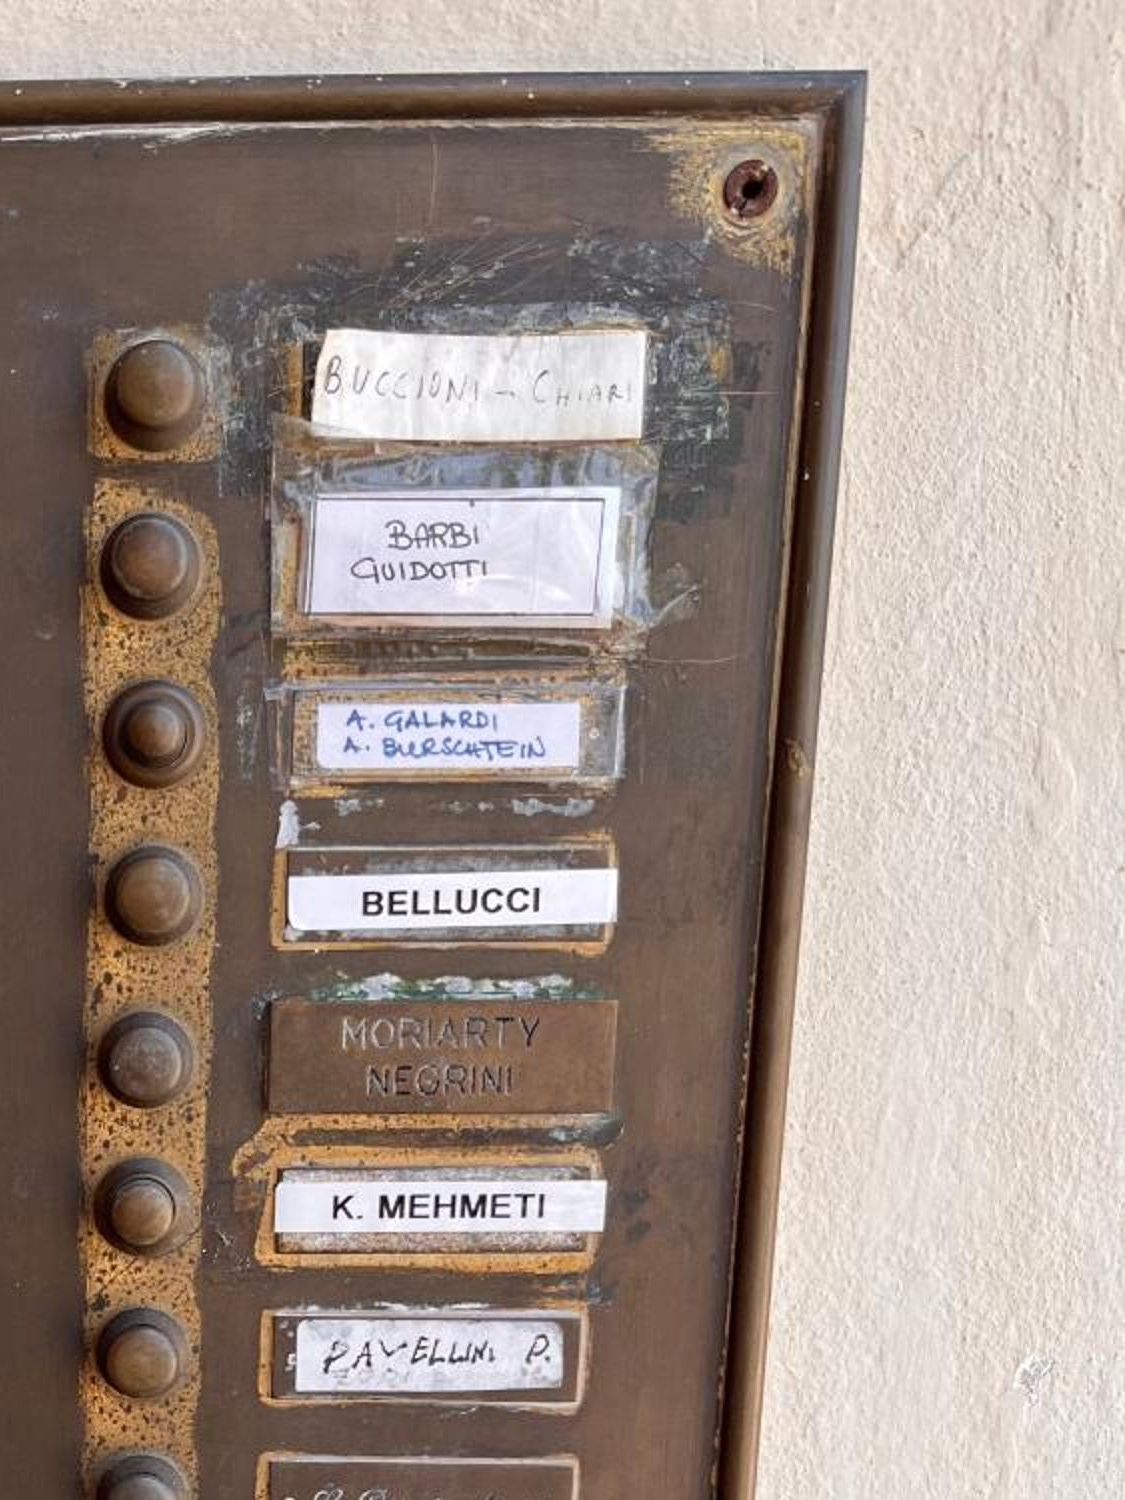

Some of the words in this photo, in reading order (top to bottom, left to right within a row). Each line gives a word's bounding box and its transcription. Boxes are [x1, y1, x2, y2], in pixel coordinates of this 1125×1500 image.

[385, 519, 480, 550] BARBI
[350, 557, 488, 585] GUIDOTTI
[346, 709, 375, 731] A.
[384, 709, 499, 732] GALARDI
[343, 736, 371, 753] A.
[362, 886, 541, 917] BELLUCCI
[341, 1016, 541, 1051] MORIARTY
[364, 1065, 514, 1097] NEGRINI
[332, 1194, 363, 1219] K.
[378, 1193, 546, 1219] MEHMETI
[525, 1334, 551, 1364] P.
